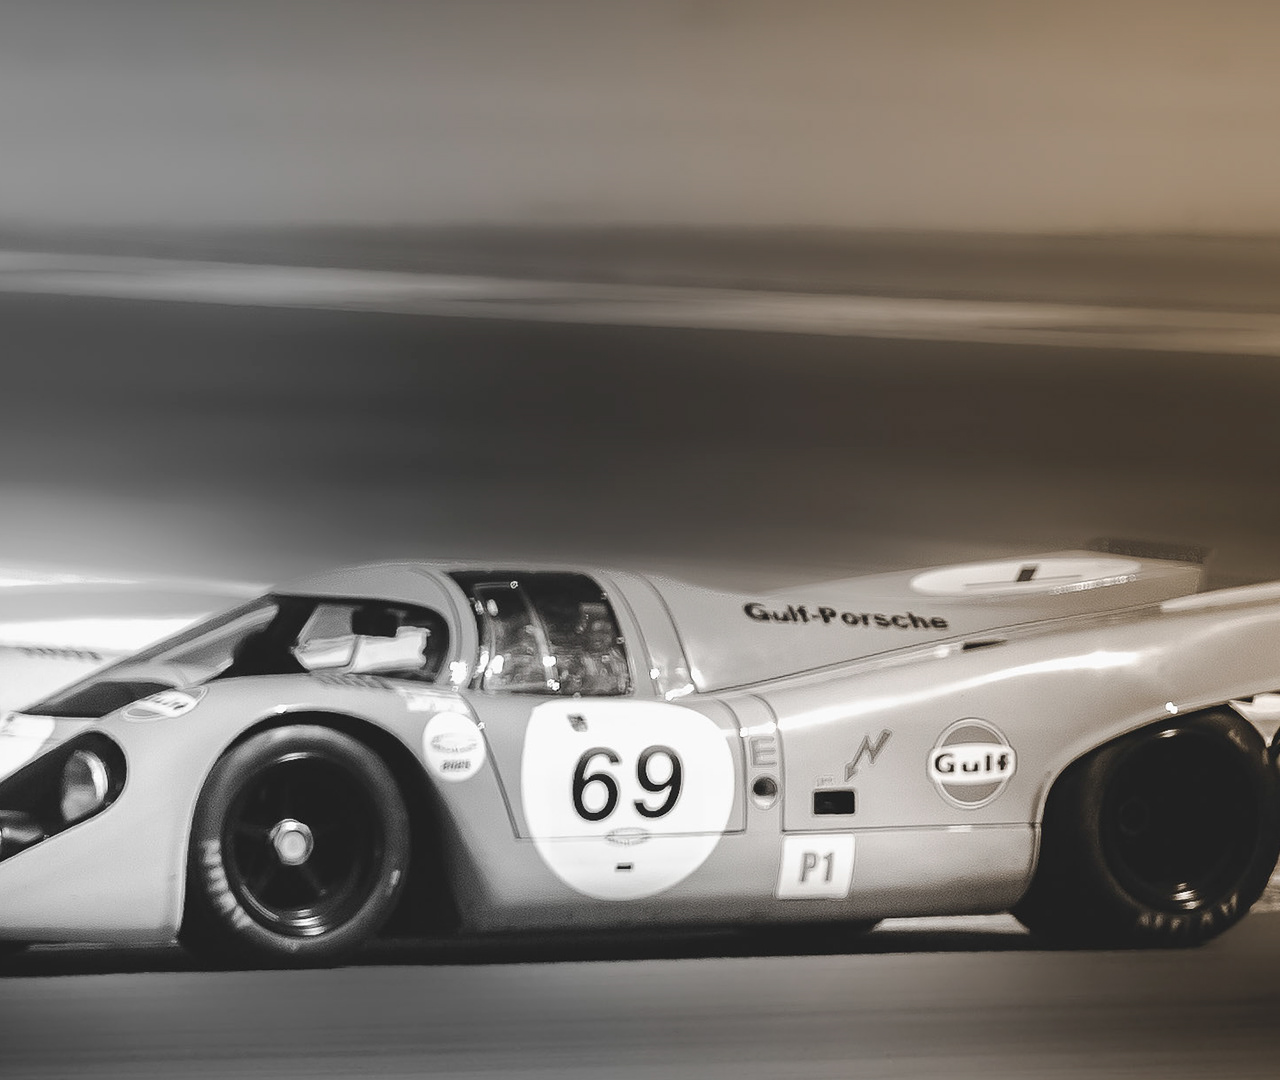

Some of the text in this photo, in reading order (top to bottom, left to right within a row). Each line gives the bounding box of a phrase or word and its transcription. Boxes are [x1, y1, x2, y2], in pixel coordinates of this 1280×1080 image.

[743, 602, 948, 629] Gulf-Porsche
[934, 753, 1009, 773] Gulf
[572, 745, 683, 822] 69
[800, 852, 835, 883] P1
